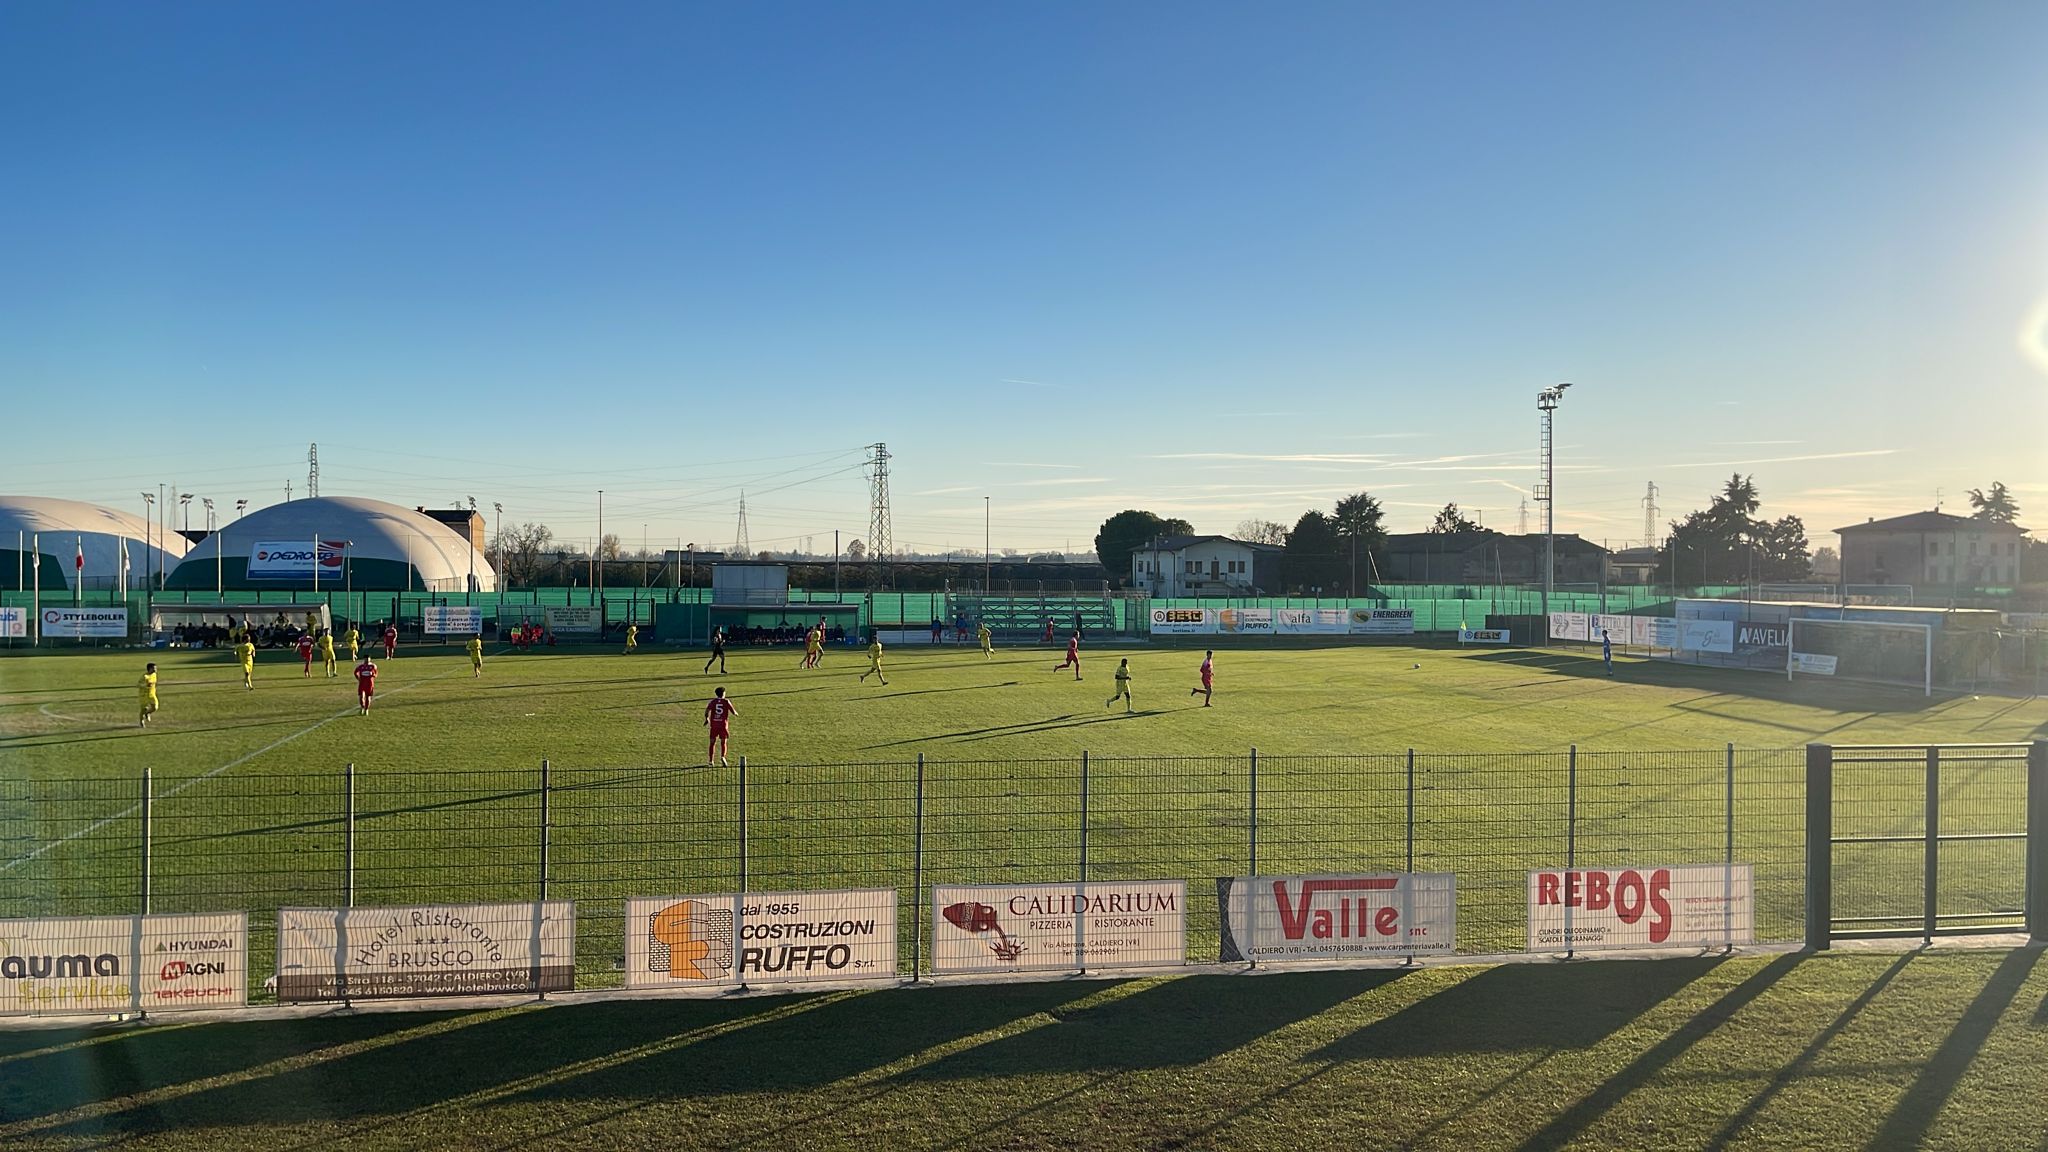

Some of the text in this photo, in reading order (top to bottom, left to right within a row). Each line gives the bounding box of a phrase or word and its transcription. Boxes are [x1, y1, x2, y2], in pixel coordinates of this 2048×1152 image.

[63, 613, 125, 621] STYLEBOILER
[1291, 613, 1311, 624] alfa
[1372, 610, 1412, 619] ENERGREEN
[715, 703, 724, 715] 5
[740, 902, 800, 917] dal 1955
[1009, 892, 1176, 916] CALIDARIUM
[1272, 878, 1427, 940] Valle snc
[1538, 869, 1672, 943] REBOS
[740, 919, 875, 940] COSTRUZIONI
[1030, 917, 1155, 930] PIZZERIA RISTORANTE
[169, 938, 233, 951] HYUNDAI
[355, 910, 502, 966] Hotel Ristorante
[1042, 941, 1054, 949] Via
[1089, 938, 1123, 947] CALDIERO
[1248, 946, 1285, 955] CALDIERO
[1285, 945, 1302, 956] (VR)
[1307, 945, 1319, 953] Tel.
[1368, 941, 1450, 952] www.carpenteriavalle.it
[388, 950, 474, 968] BRUSCO
[738, 943, 851, 973] RUFFO
[161, 961, 225, 980] MAGNI
[325, 976, 344, 986] Via
[375, 975, 394, 985] 118
[443, 971, 503, 982] CALDIERO
[506, 970, 530, 981] (VR)
[18, 978, 131, 1004] Service
[341, 987, 362, 997] 045
[425, 981, 536, 993] www.hotelbrusco.it
